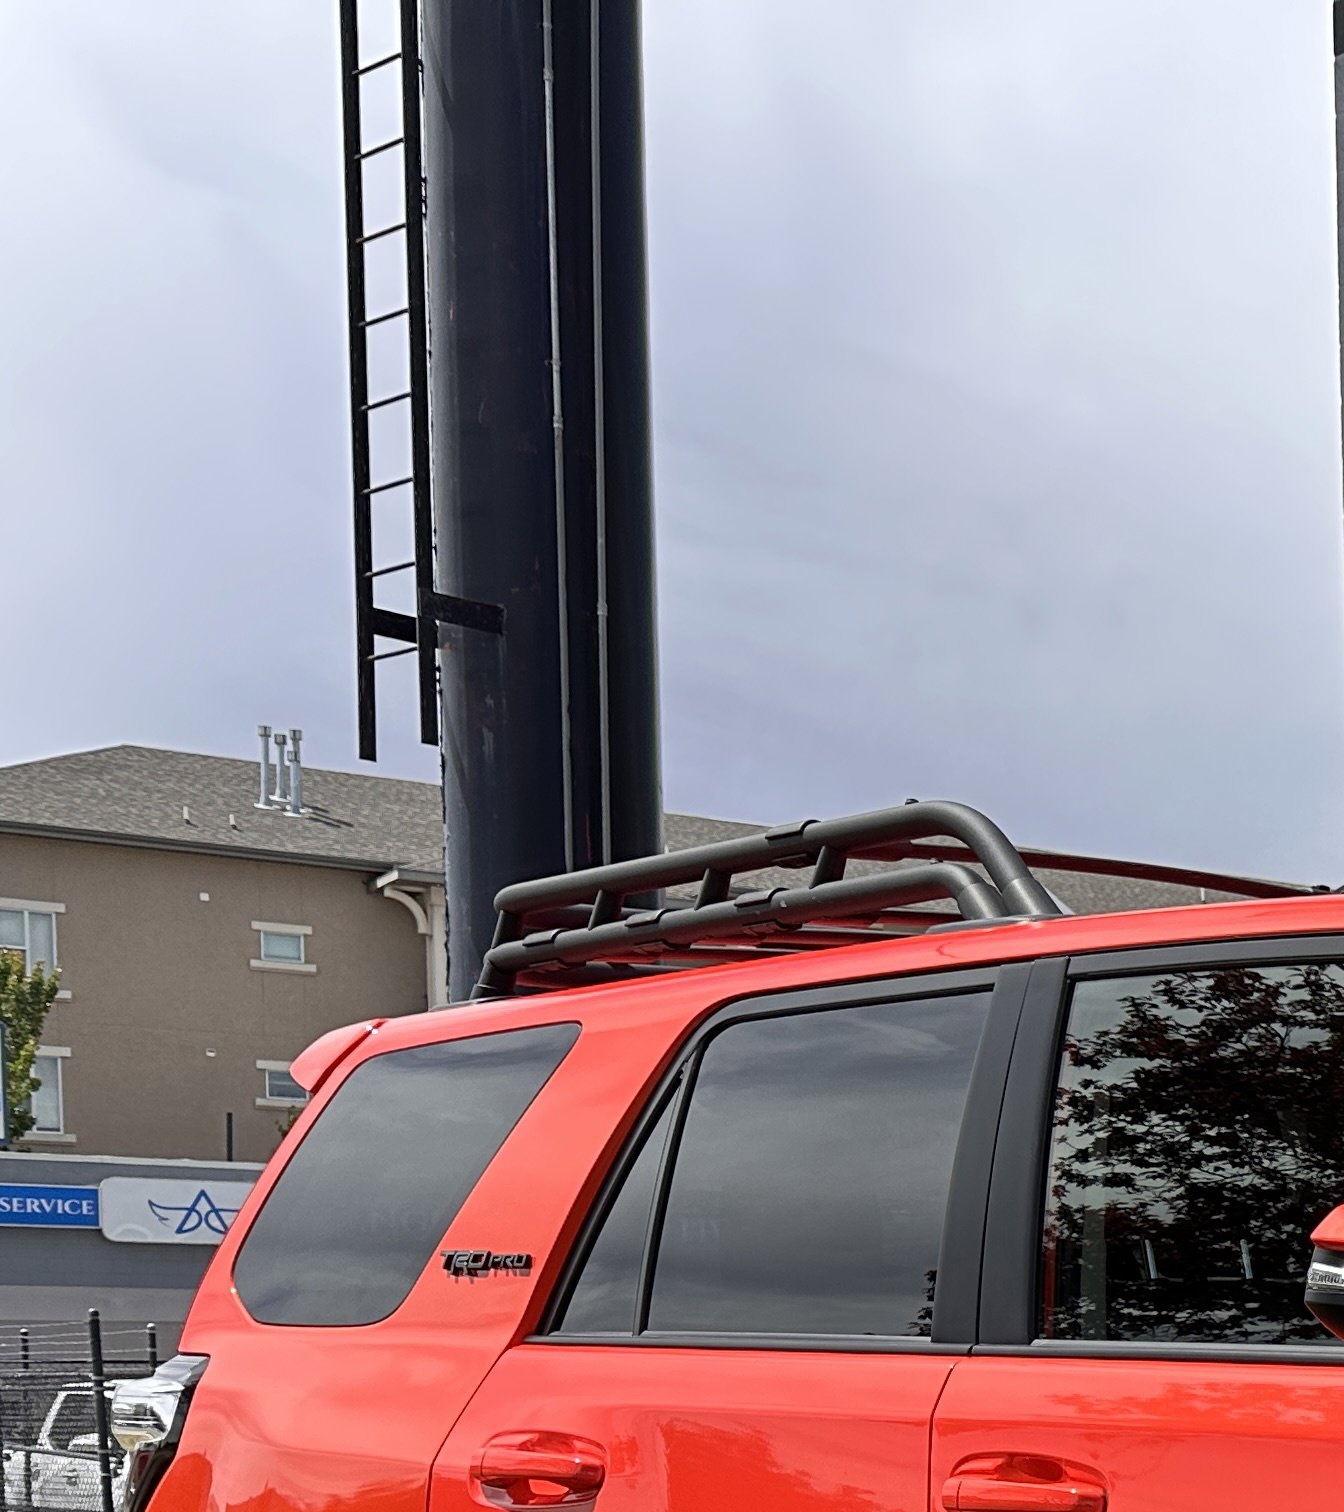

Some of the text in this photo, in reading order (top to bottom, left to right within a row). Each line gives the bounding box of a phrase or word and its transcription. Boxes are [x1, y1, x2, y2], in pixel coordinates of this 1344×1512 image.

[0, 1196, 95, 1216] SERVICE
[440, 1250, 534, 1277] TRD PRO
